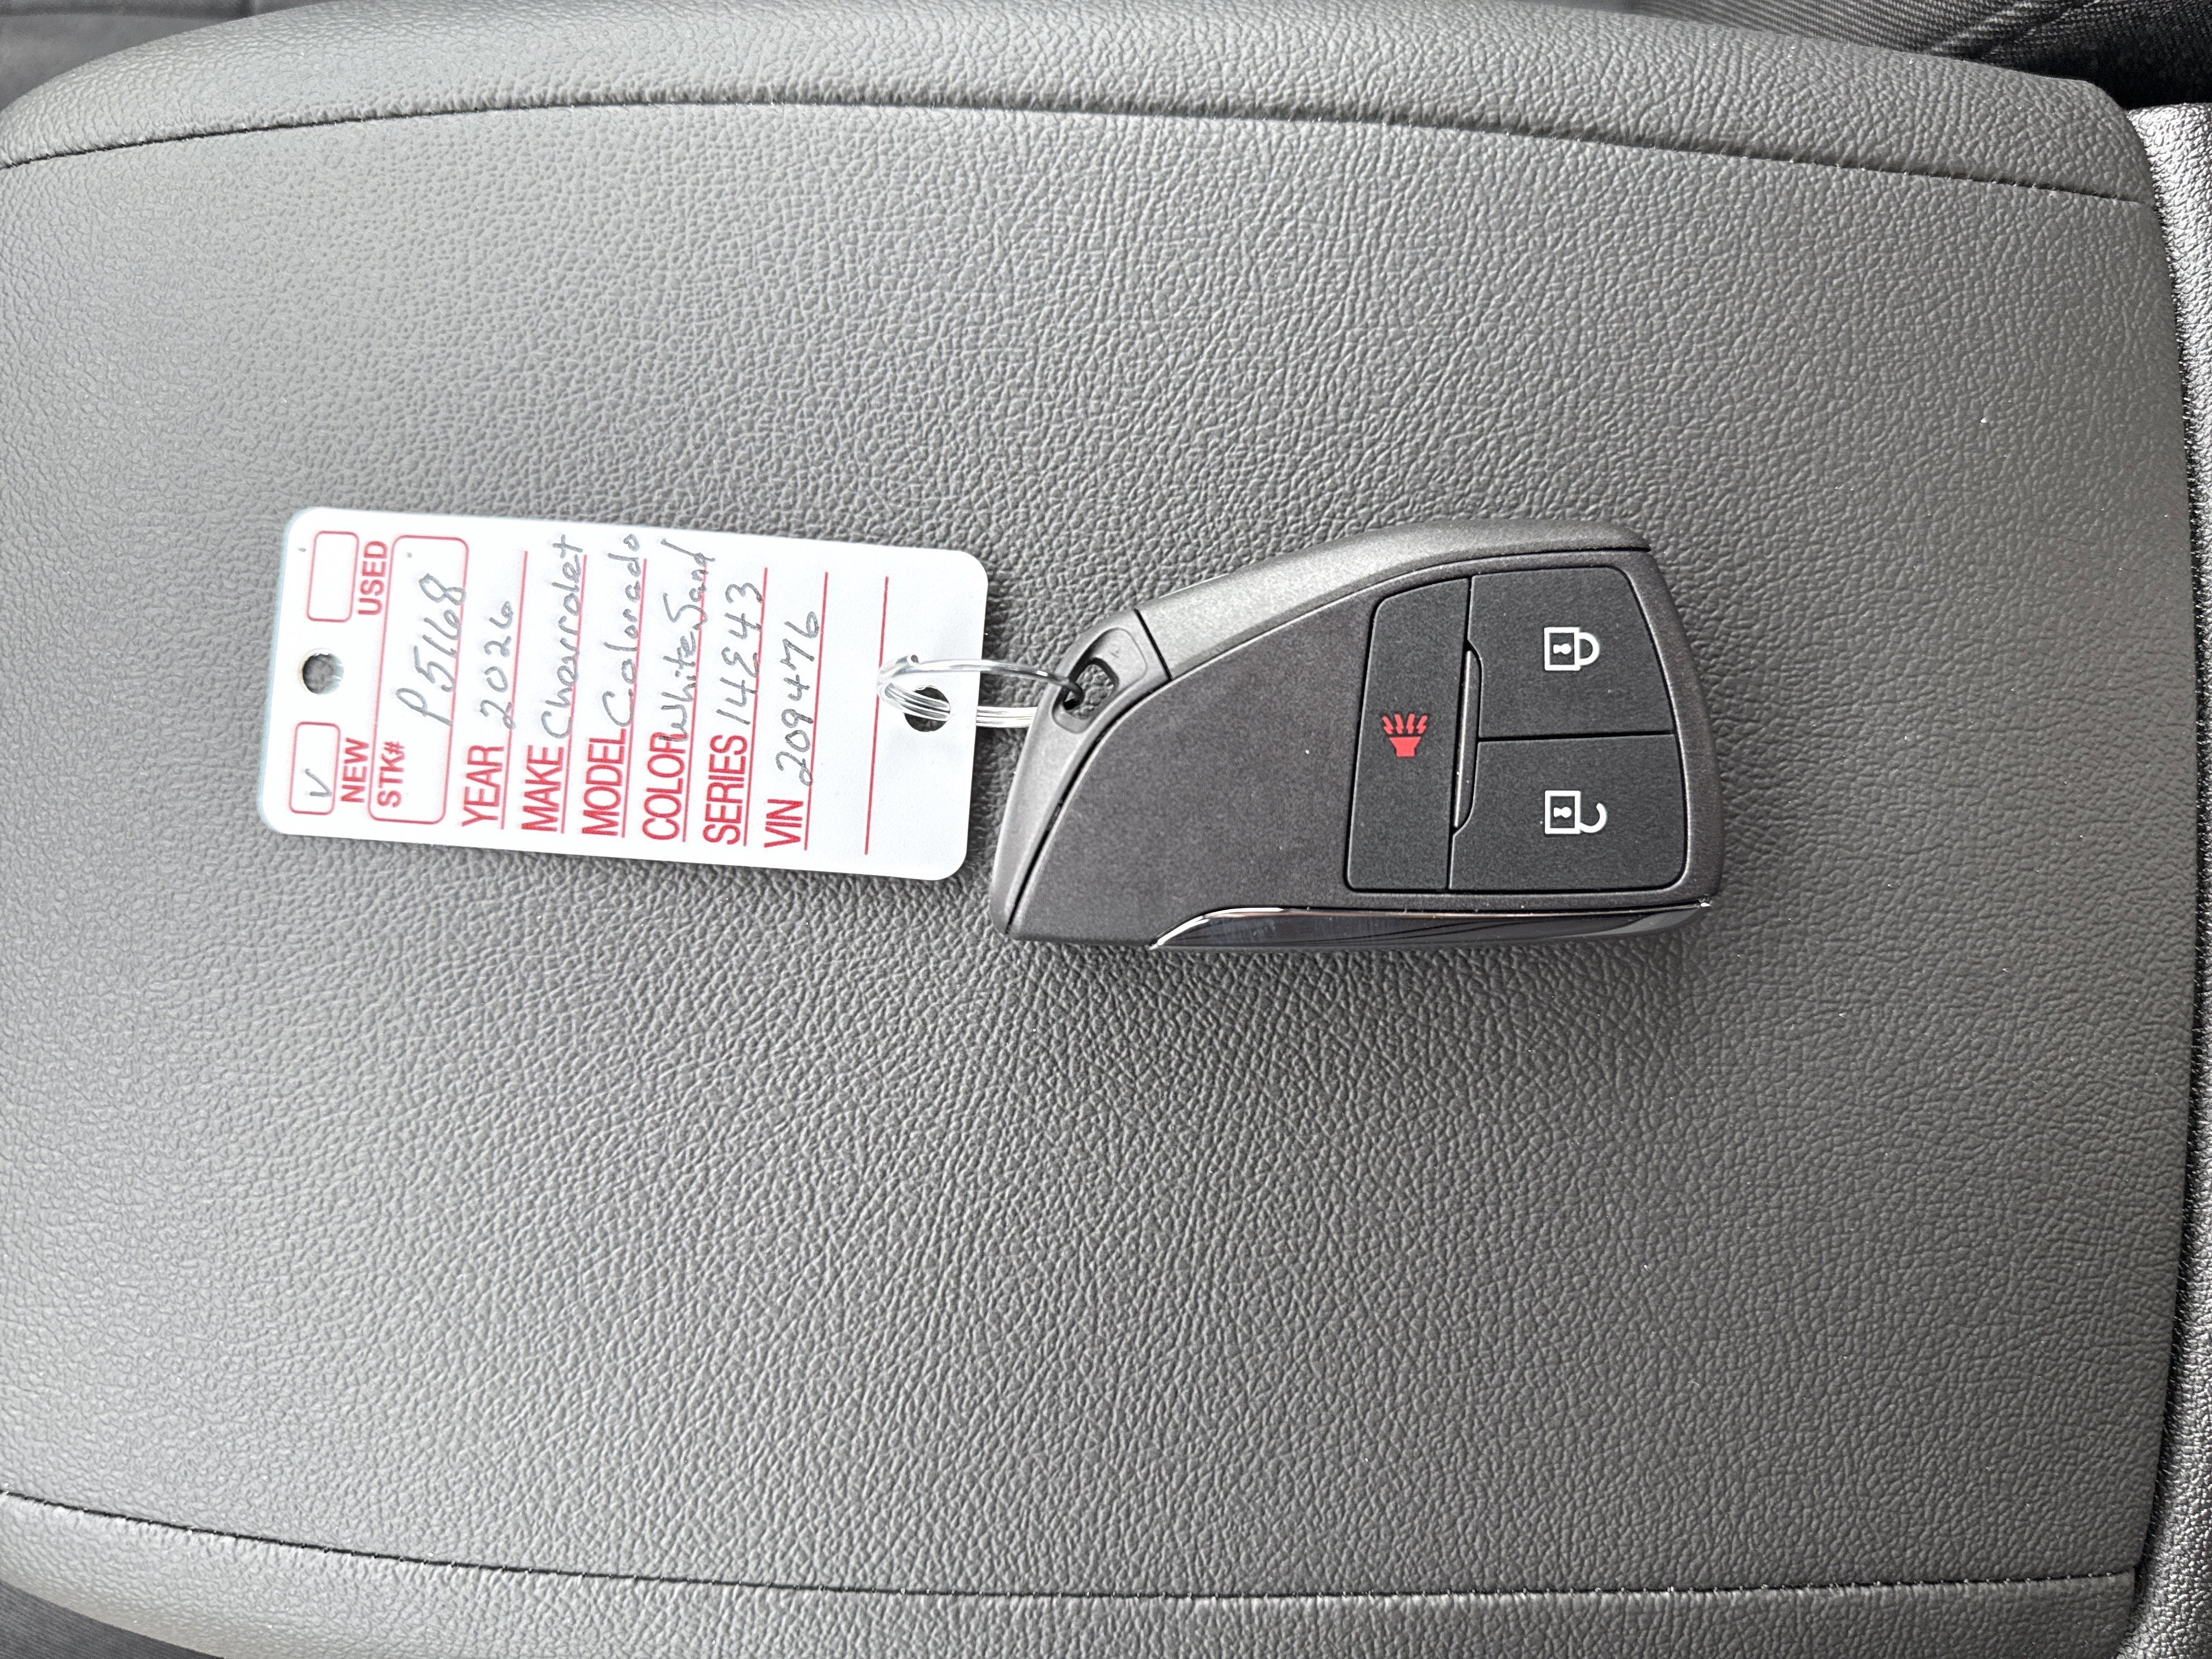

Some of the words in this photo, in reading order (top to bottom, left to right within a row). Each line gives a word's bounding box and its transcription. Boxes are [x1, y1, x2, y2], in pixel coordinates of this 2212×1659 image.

[358, 540, 388, 616] USED
[602, 533, 640, 727] Colorado
[396, 573, 466, 727] P5168
[479, 601, 515, 730] 2026
[541, 534, 583, 738] Chevrolet
[775, 611, 820, 786] 209476
[341, 737, 370, 803] NEW
[377, 741, 405, 808] STK#
[461, 745, 505, 827] YEAR
[521, 745, 564, 832] MAKE
[581, 727, 627, 836] MODEL
[642, 731, 686, 840] COLOR
[702, 733, 748, 845] SERIES
[764, 798, 804, 848] VIN
